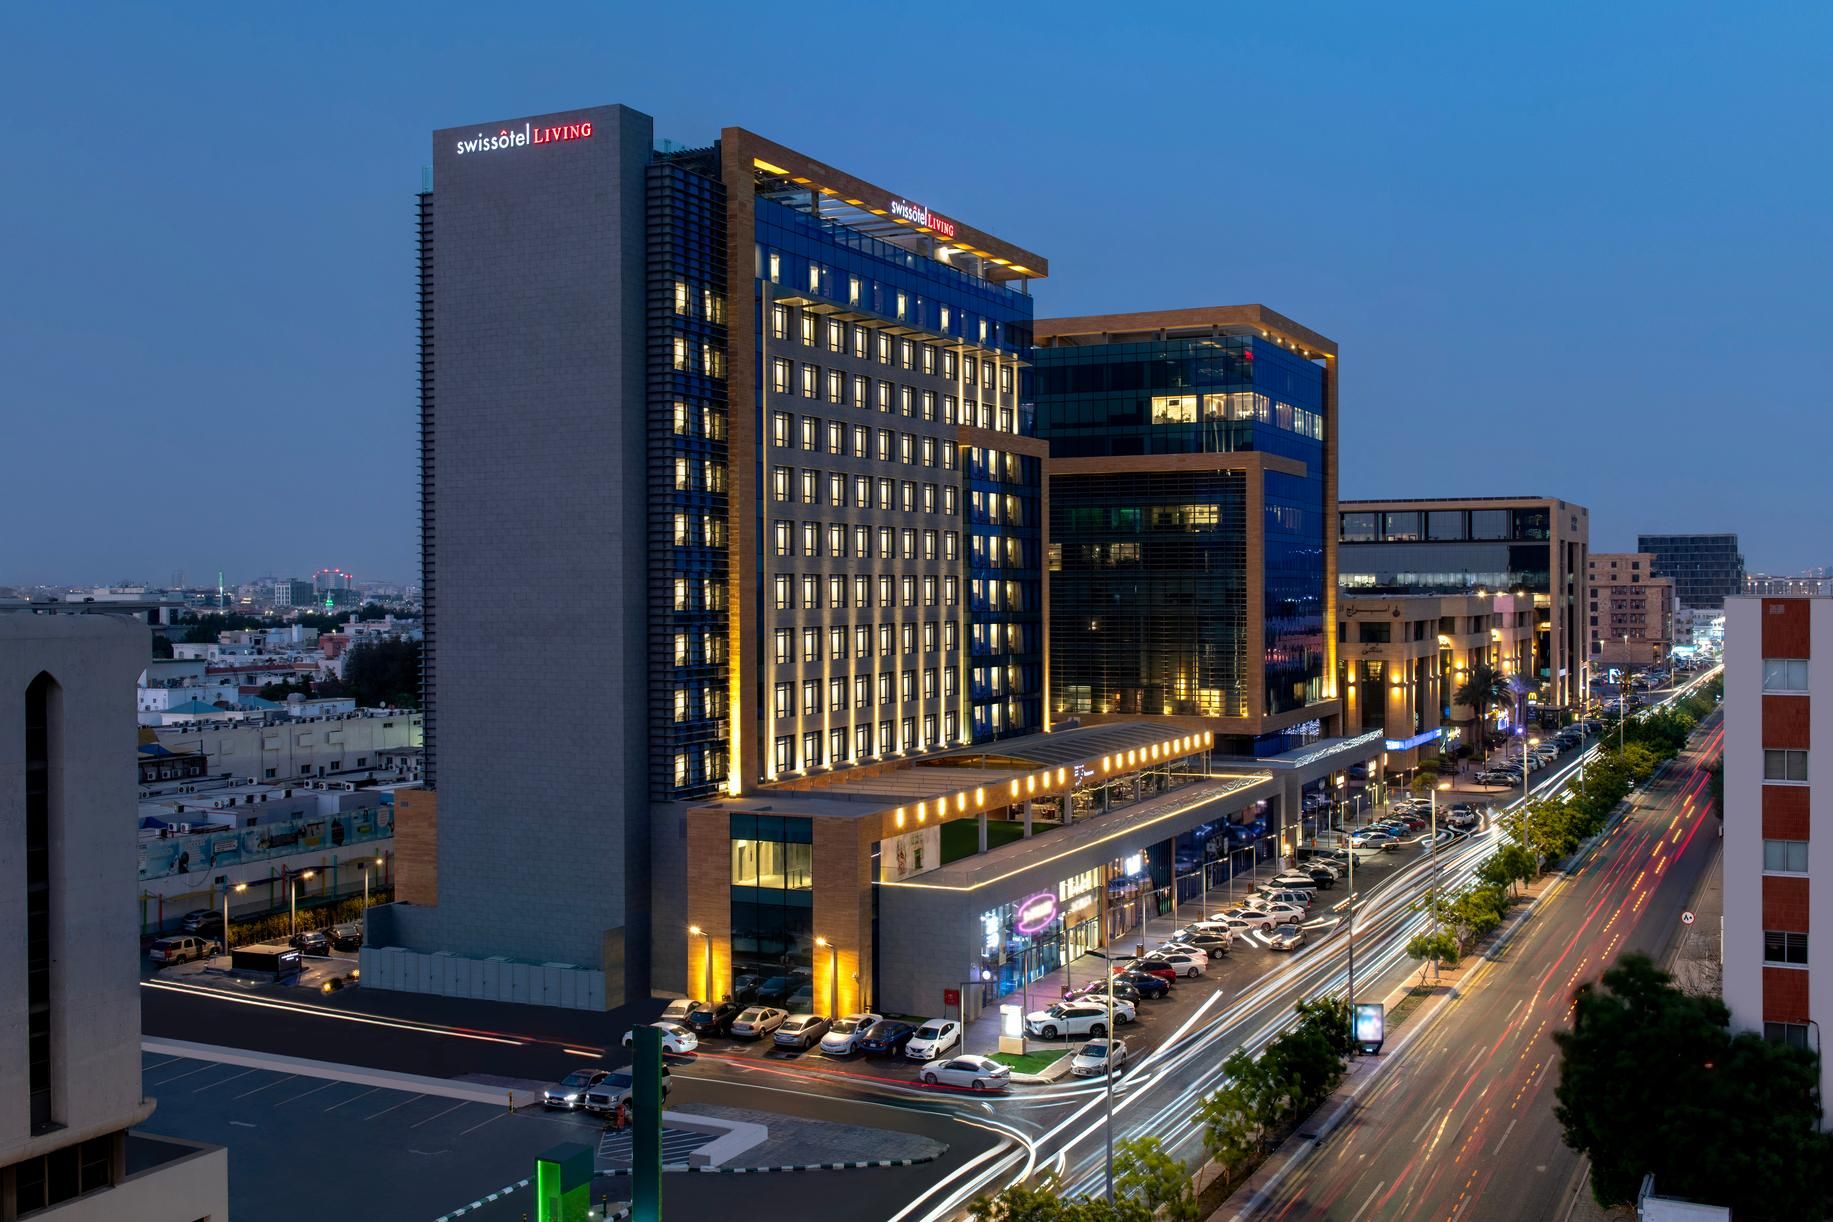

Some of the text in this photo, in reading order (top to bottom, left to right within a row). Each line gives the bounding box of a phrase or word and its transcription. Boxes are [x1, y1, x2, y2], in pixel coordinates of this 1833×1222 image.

[457, 123, 592, 154] swissôtel LIVING
[891, 200, 954, 237] swissôtel LIVING
